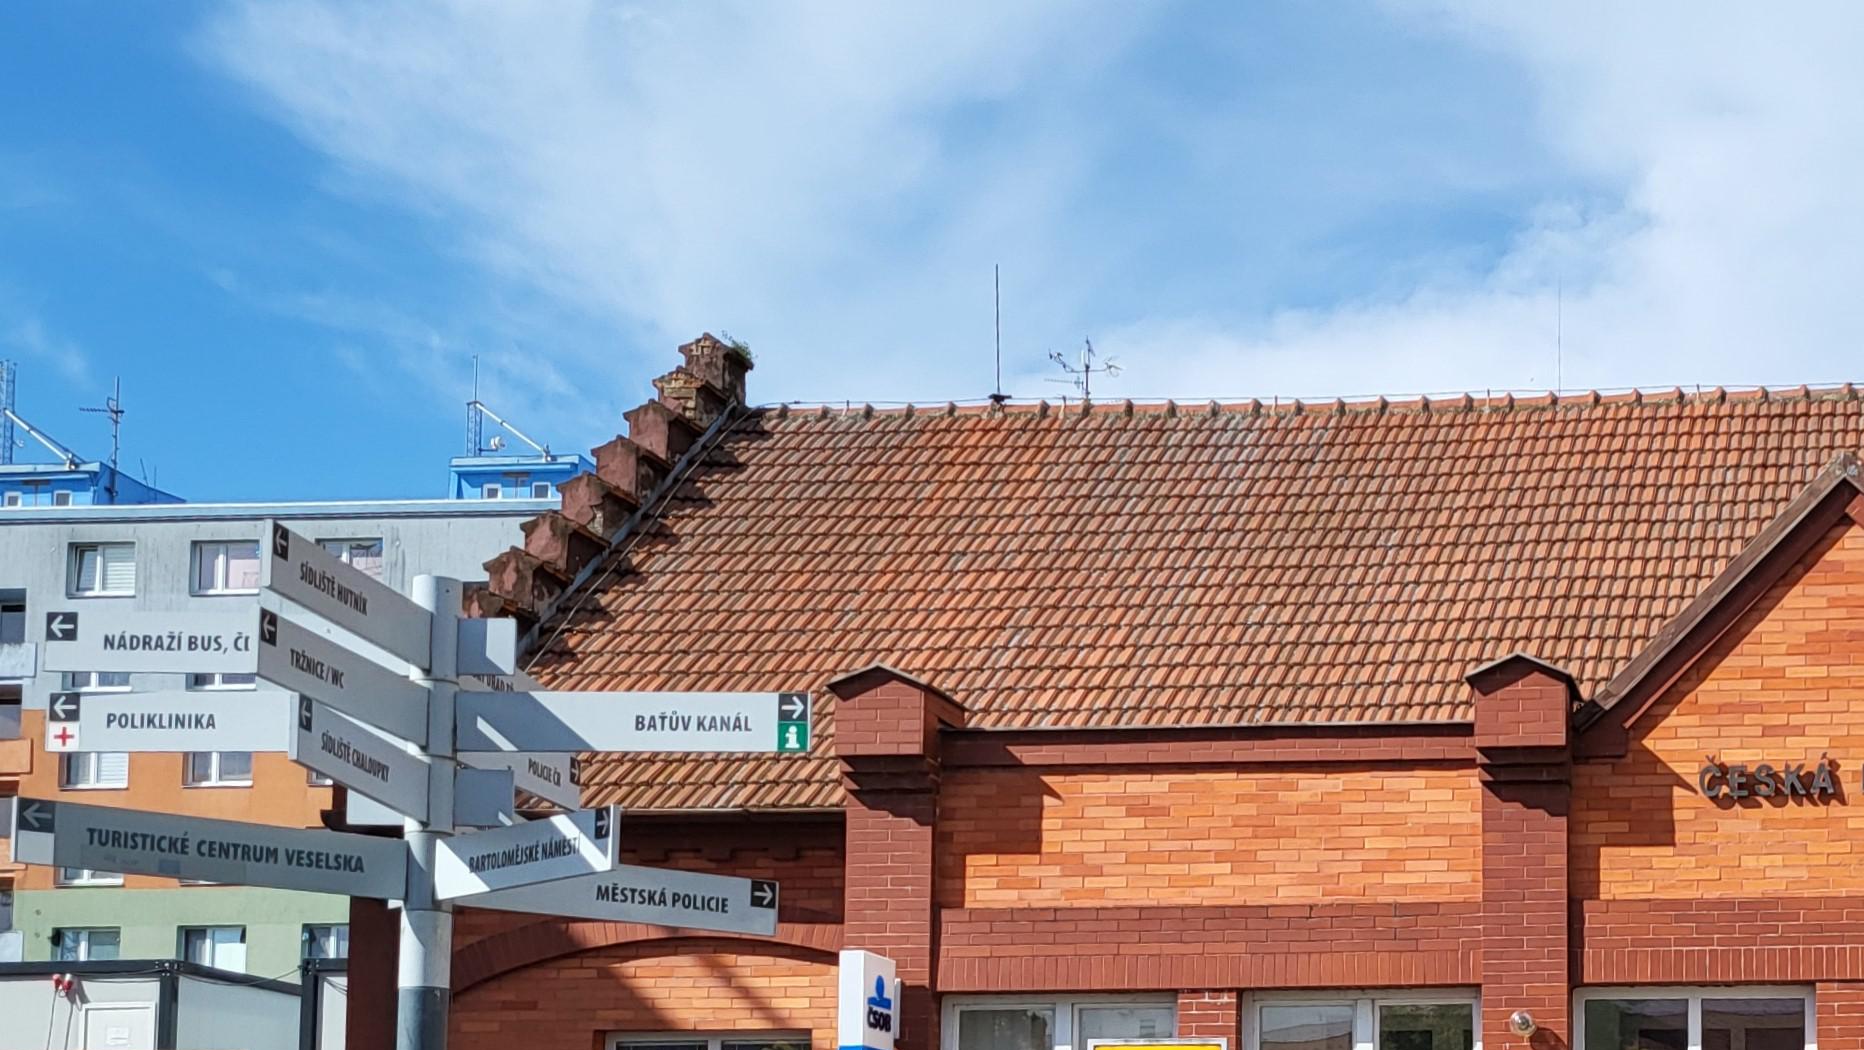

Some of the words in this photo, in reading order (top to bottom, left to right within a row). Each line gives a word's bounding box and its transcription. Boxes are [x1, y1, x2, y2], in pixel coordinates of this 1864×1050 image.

[299, 559, 336, 598] SÍDLIŠTĚ
[337, 583, 368, 616] HUTNÍK
[103, 631, 183, 651] NÁDRAŽÍ
[188, 635, 227, 655] BUS,
[290, 648, 325, 680] TRŽNICE
[331, 669, 345, 689] WC
[106, 713, 216, 730] POLIKLINIKA
[634, 710, 692, 732] BAŤŮV
[696, 712, 753, 732] KANÁL
[320, 730, 352, 764] SÍDLIŠTĚ
[351, 748, 391, 784] CHALOUPKY
[528, 758, 550, 782] POLICIE
[550, 769, 562, 787] ČR
[1700, 752, 1832, 798] ČESKÁ
[86, 827, 190, 856] TURISTICKÉ
[196, 839, 279, 865] CENTRUM
[284, 847, 365, 874] VESELSKA
[469, 841, 540, 873] BARTOLOMĚJSKÉ
[595, 883, 668, 907] MĚSTSKÁ
[671, 892, 729, 914] POLICIE
[867, 1007, 891, 1033] ČSOB
